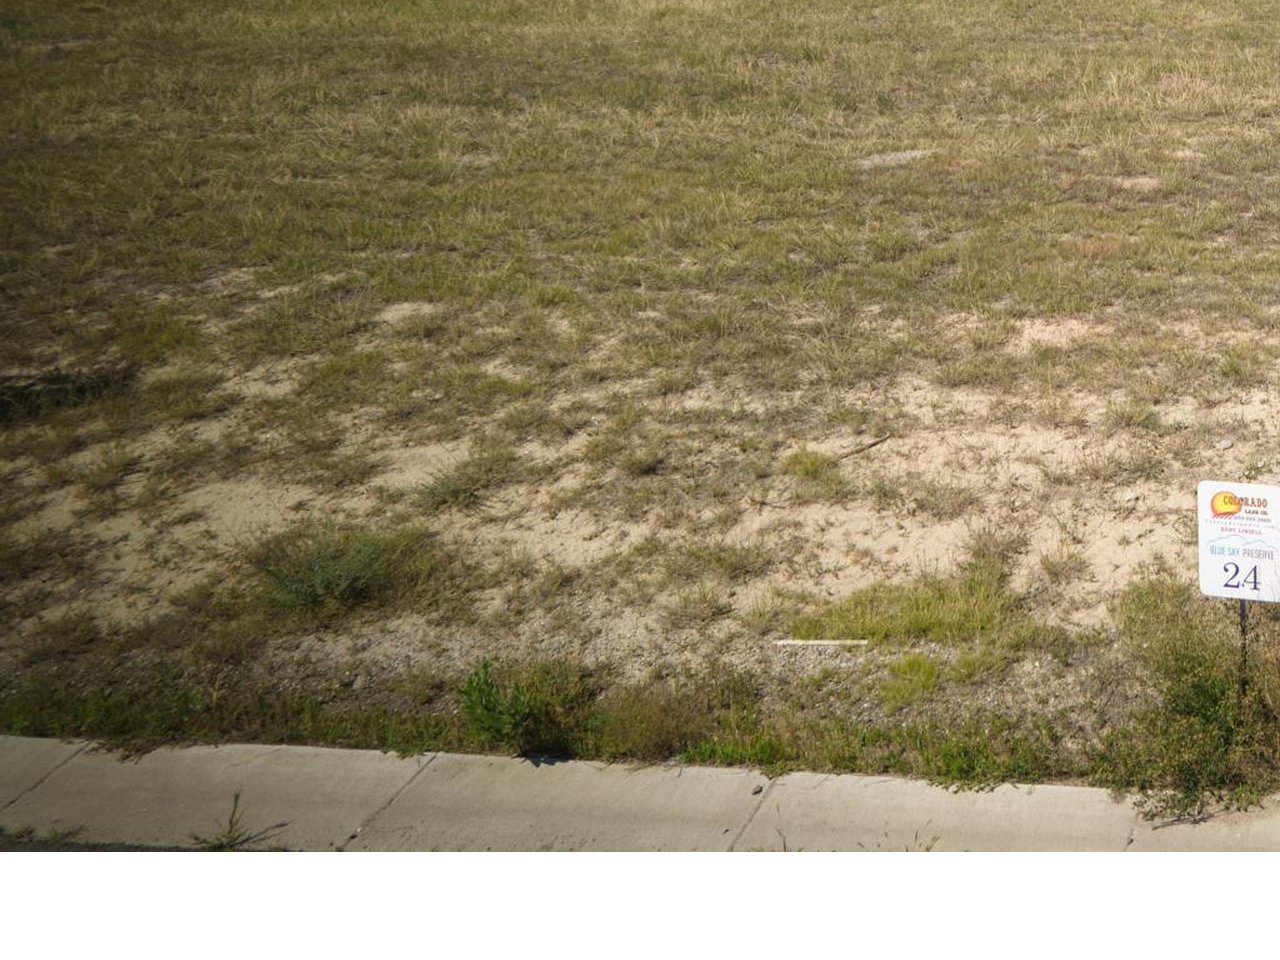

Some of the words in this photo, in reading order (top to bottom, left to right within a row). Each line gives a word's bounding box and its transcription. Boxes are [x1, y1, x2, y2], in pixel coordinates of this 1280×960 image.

[1223, 496, 1268, 508] COLORADO
[1210, 546, 1226, 555] BLUE
[1228, 548, 1240, 556] SKY
[1242, 548, 1274, 560] PRESERVE
[1223, 562, 1260, 591] 24
